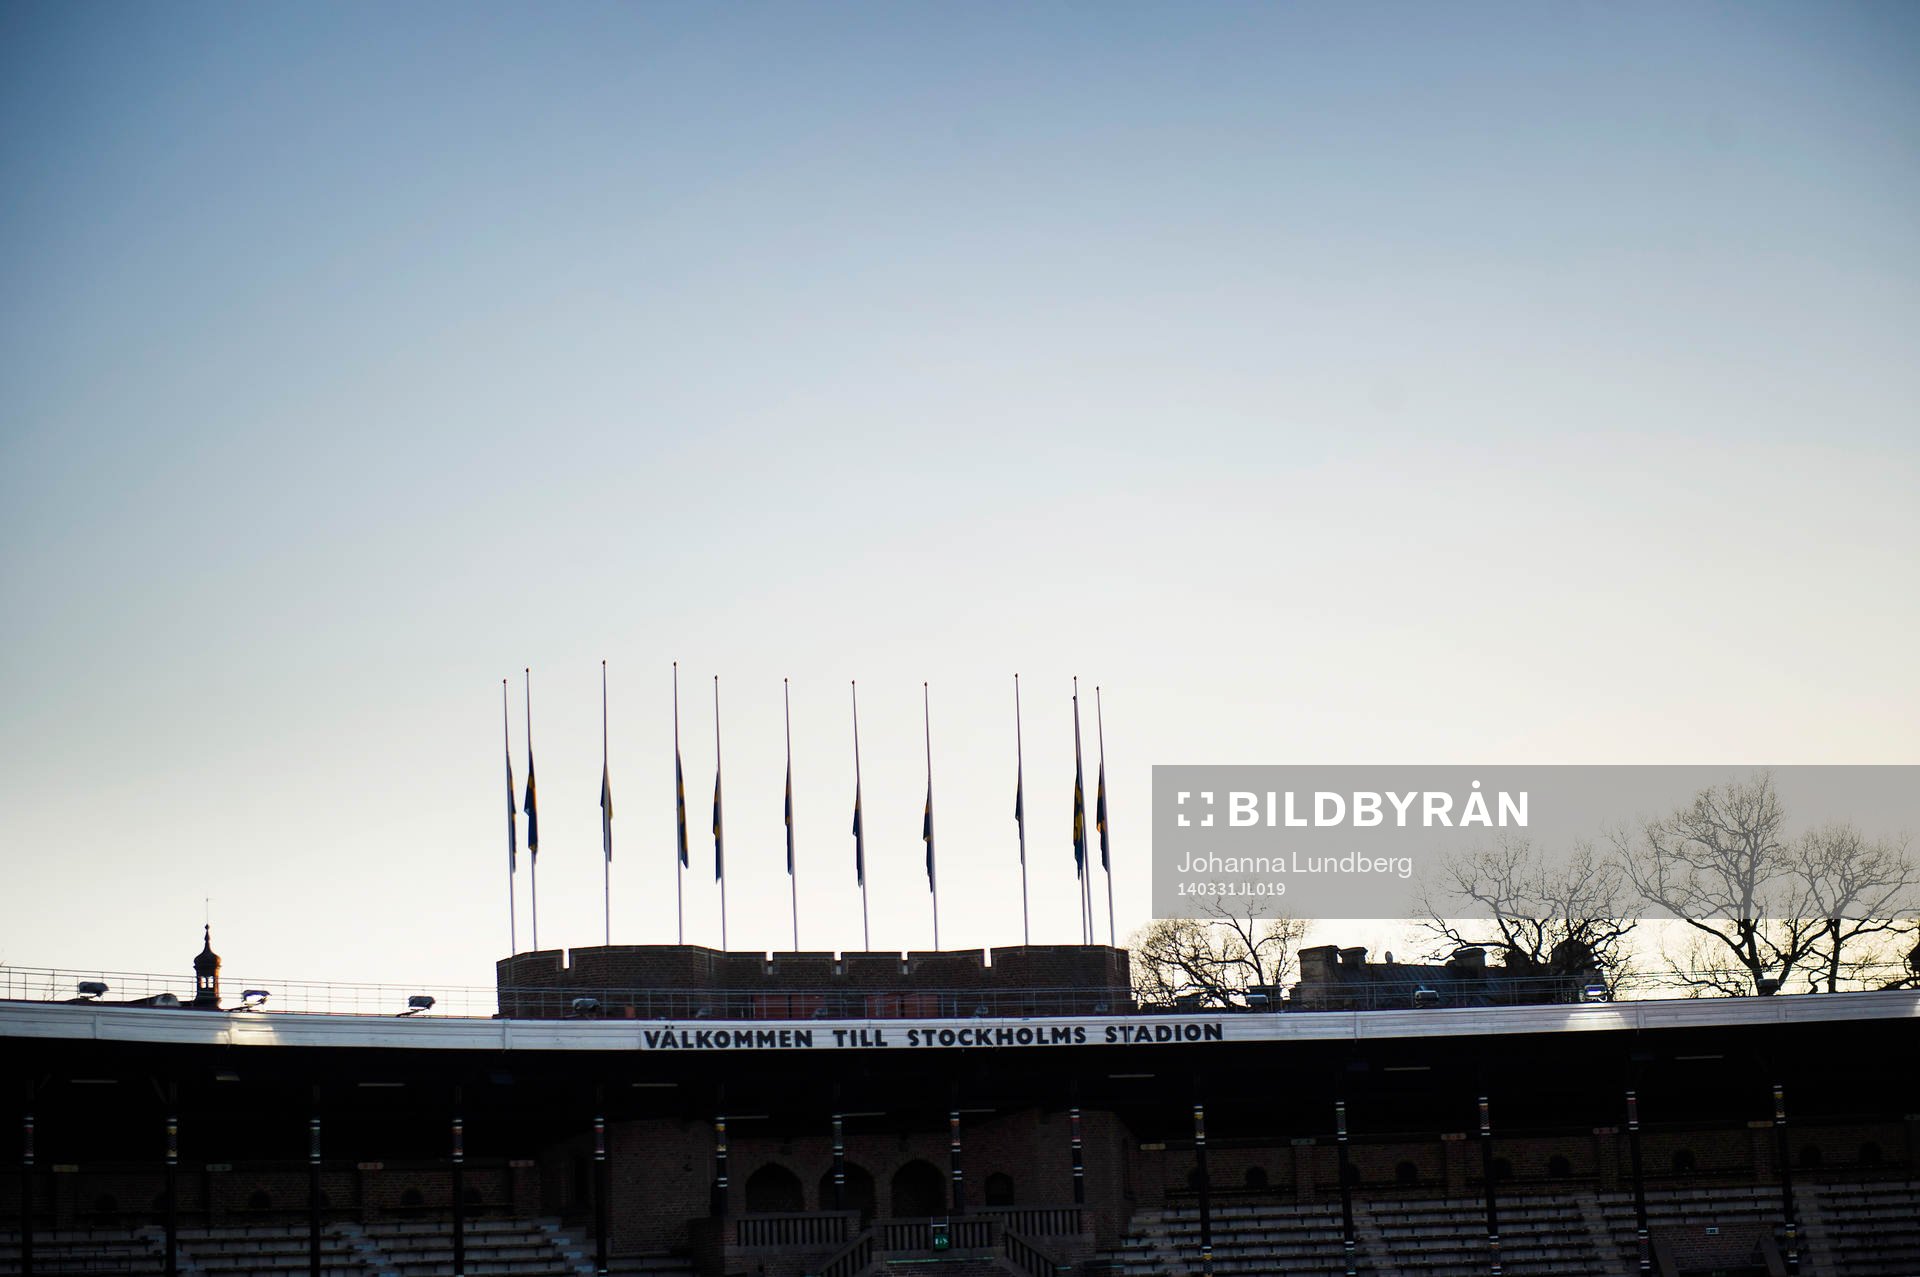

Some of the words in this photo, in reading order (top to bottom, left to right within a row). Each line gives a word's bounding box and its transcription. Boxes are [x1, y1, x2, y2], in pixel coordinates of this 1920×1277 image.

[644, 1026, 813, 1049] VÄLKOMMEN
[833, 1029, 888, 1047] TILL
[907, 1026, 1087, 1047] STOCKHOLMS
[1105, 1023, 1224, 1043] STADION
